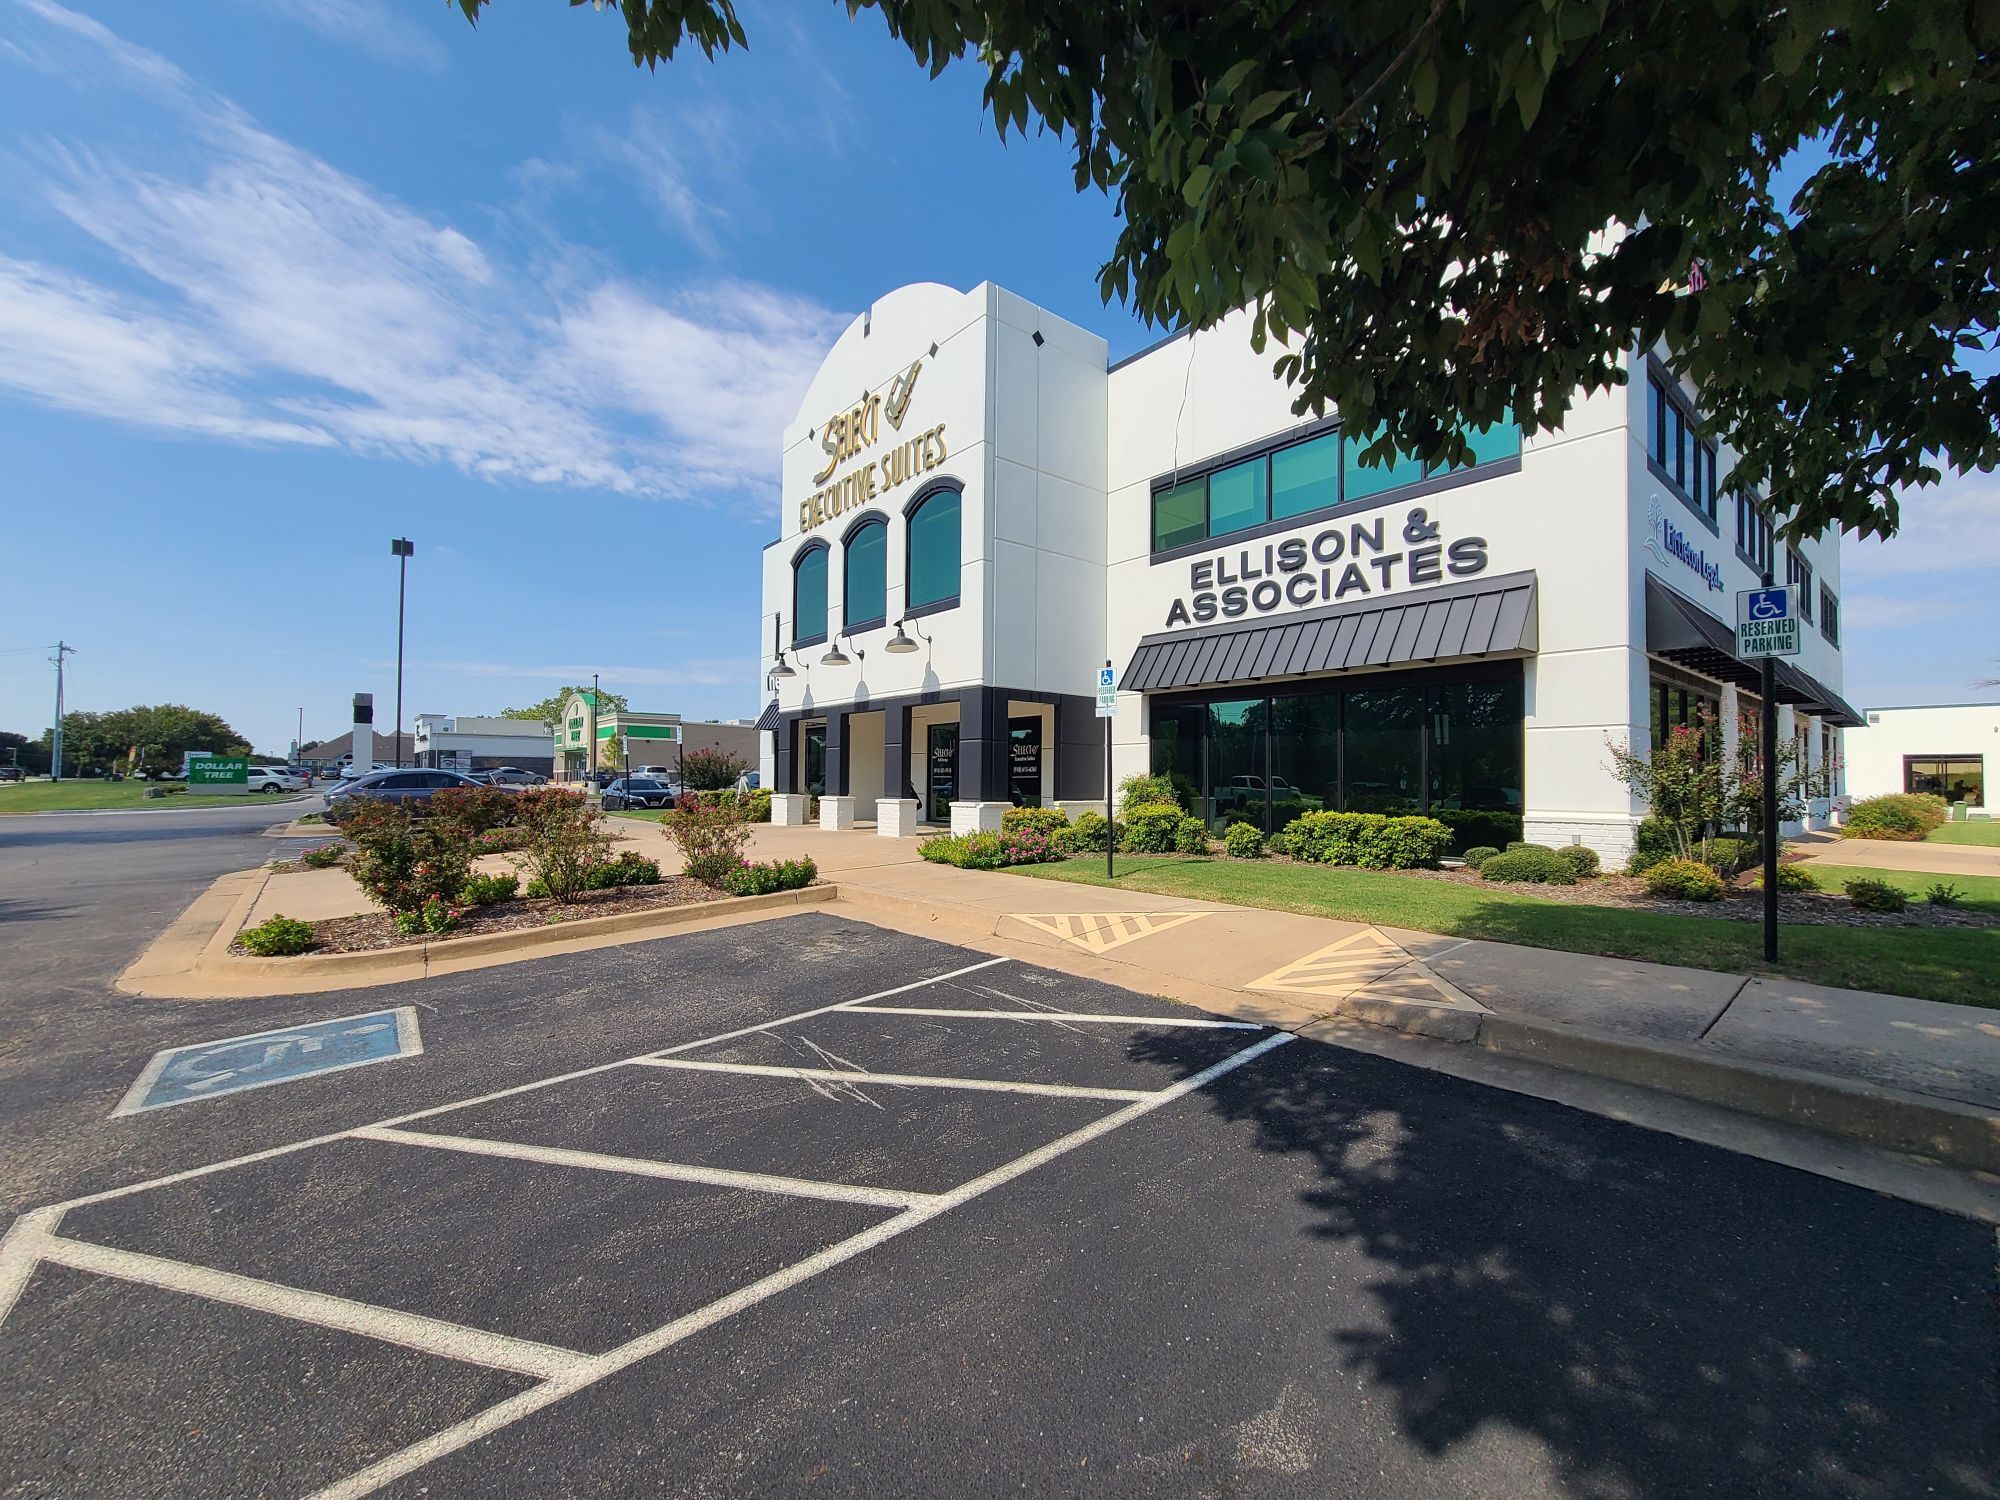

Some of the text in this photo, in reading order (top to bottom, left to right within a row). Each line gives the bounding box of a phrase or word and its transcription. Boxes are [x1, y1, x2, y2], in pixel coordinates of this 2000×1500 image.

[813, 394, 881, 486] SELECT
[799, 423, 948, 532] EXECUTIVE SUITES
[1190, 507, 1439, 592] ELLISON &
[1165, 536, 1488, 627] ASSOCIATES
[1700, 550, 1719, 591] Legal
[1741, 619, 1795, 637] RESERVED
[1744, 635, 1792, 653] PARKING
[932, 747, 949, 759] SELECT
[1010, 744, 1032, 757] SELECT
[204, 771, 233, 779] TREE
